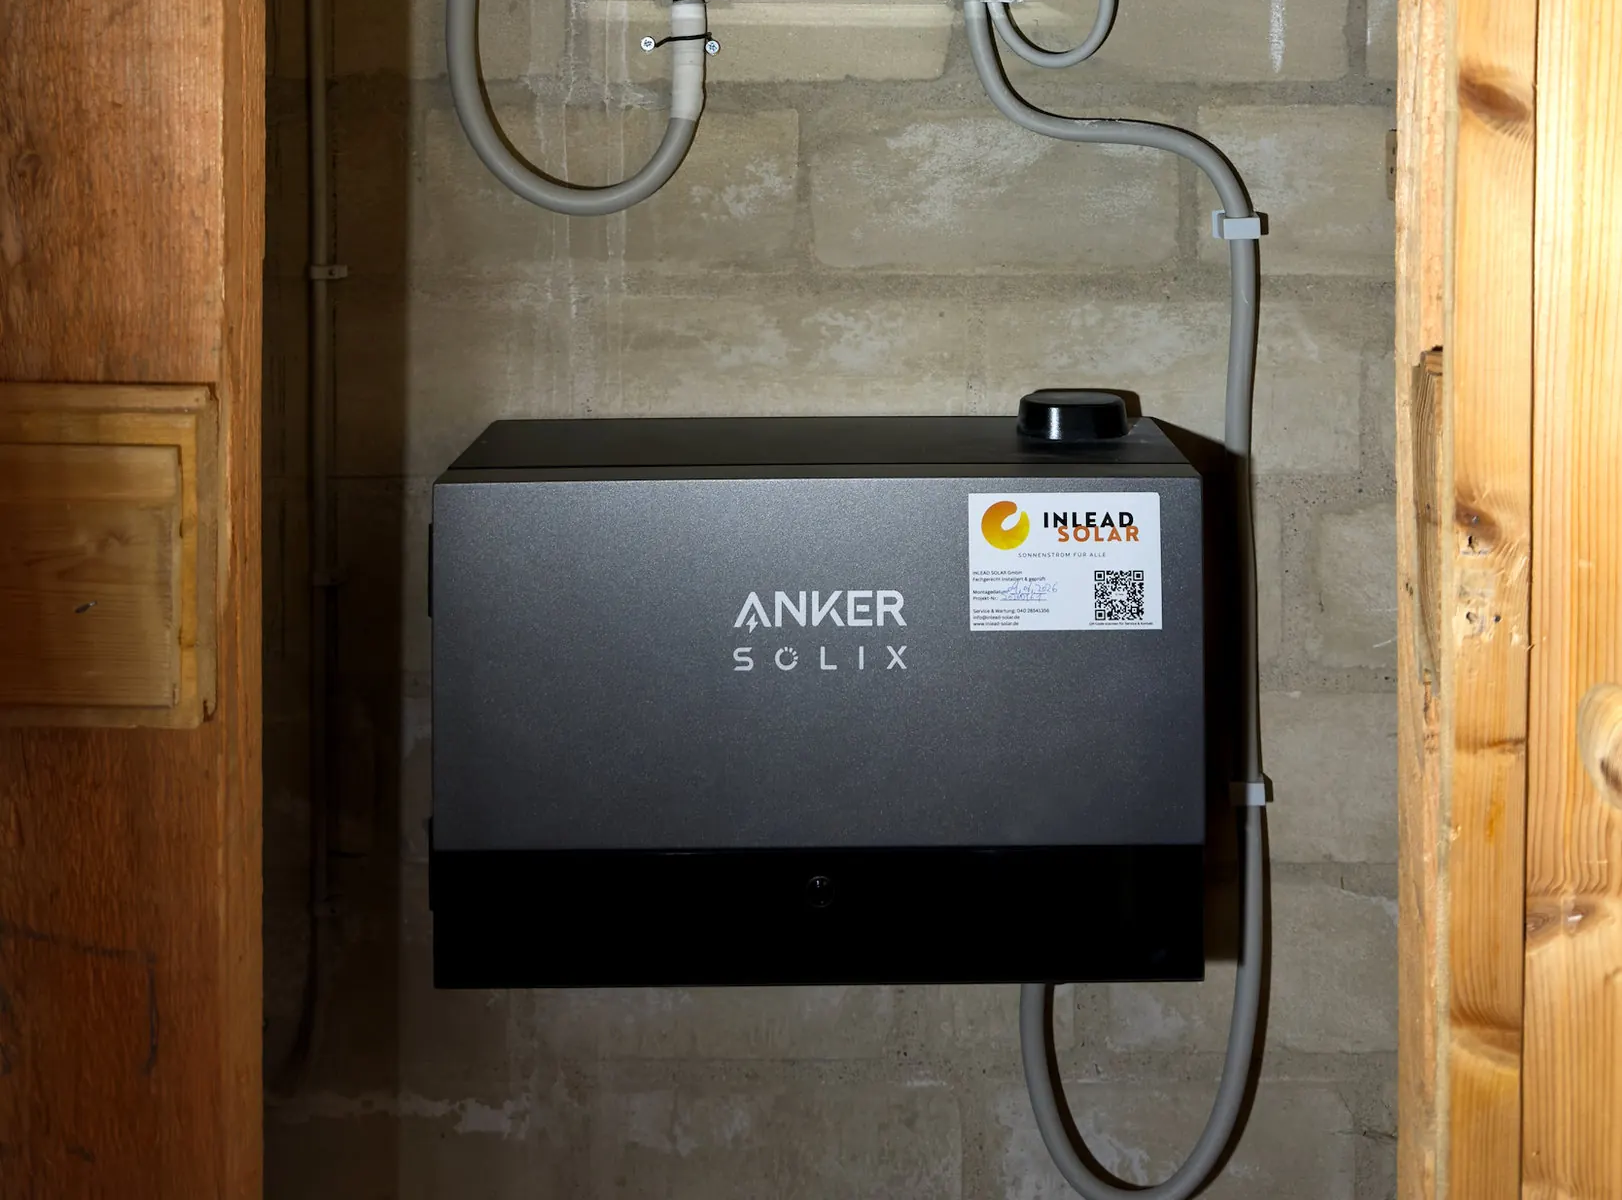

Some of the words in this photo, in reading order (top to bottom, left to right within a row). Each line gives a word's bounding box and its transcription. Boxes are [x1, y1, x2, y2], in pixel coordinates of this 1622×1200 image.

[1044, 512, 1134, 528] INLEAD
[1058, 526, 1140, 542] SOLAR
[734, 590, 907, 632] ANKER
[733, 646, 907, 671] SOLIX
